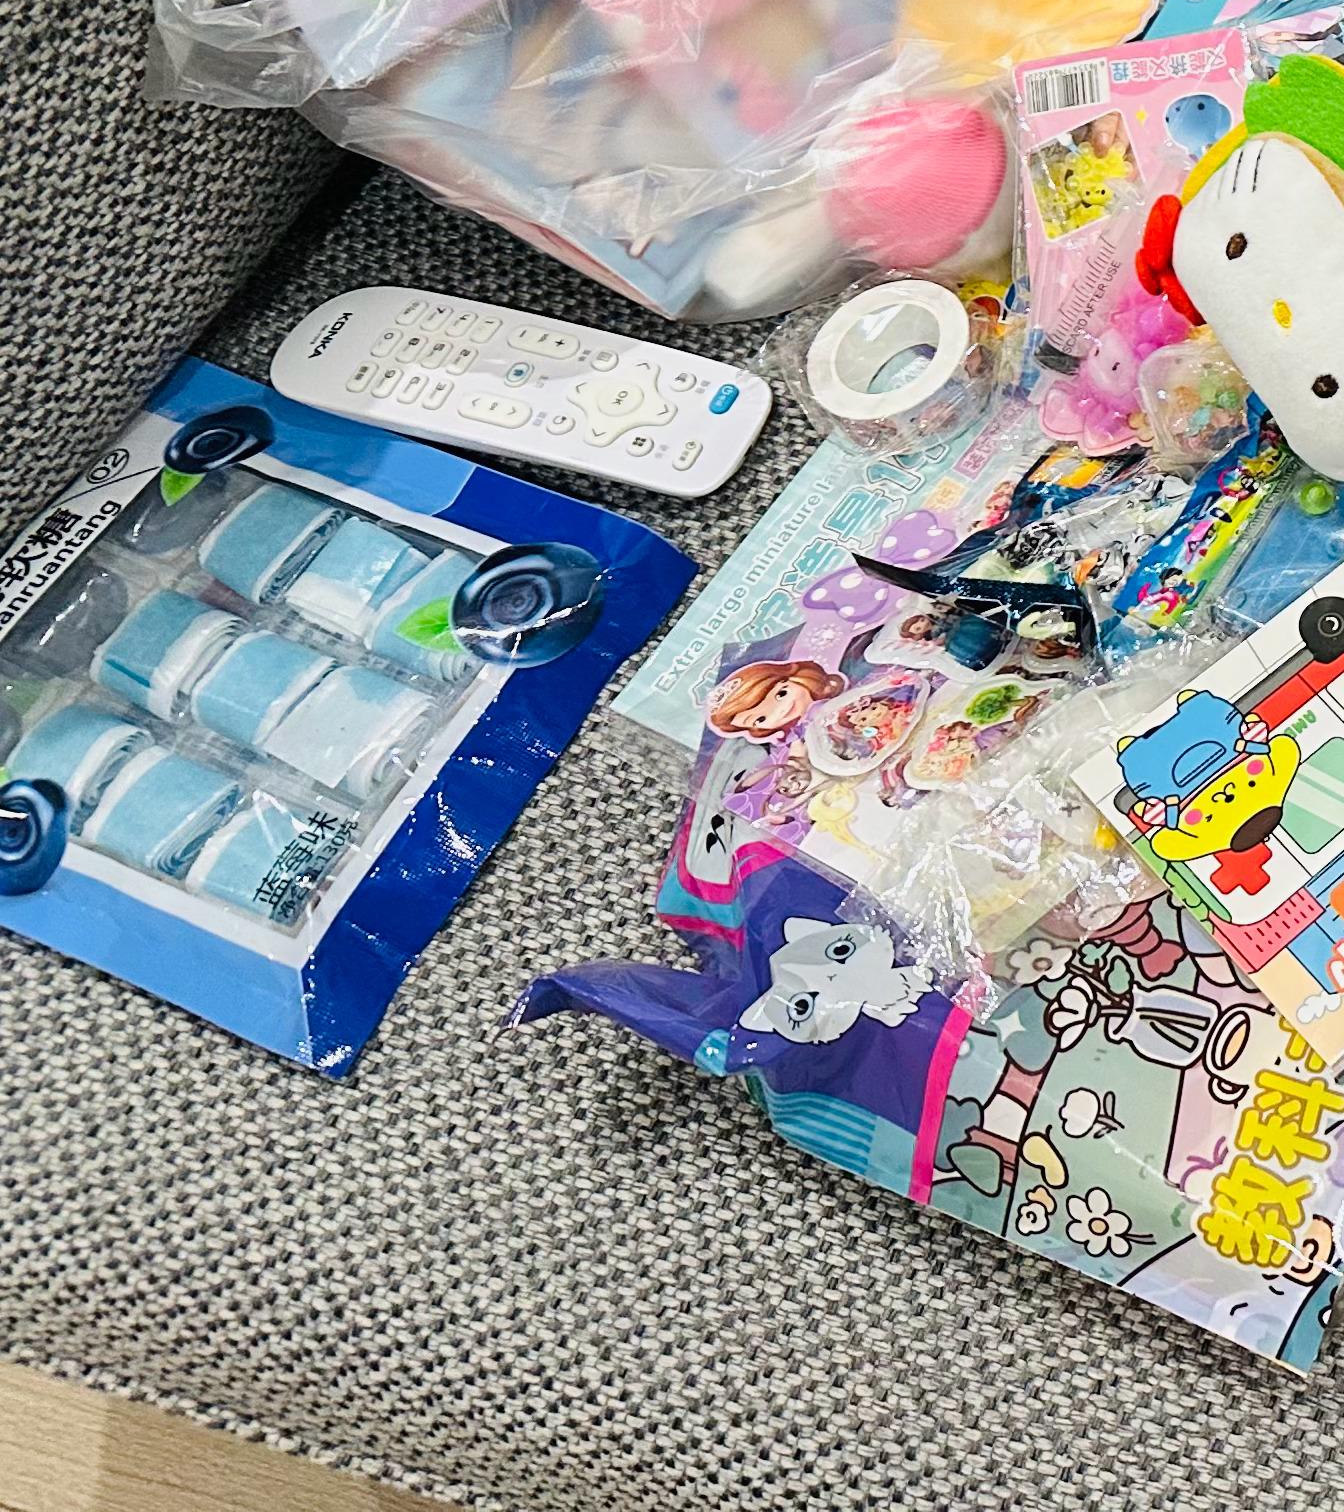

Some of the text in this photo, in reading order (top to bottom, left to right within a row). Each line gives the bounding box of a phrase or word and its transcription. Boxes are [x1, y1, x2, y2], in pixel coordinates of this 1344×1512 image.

[1083, 282, 1108, 318] AFTER
[1104, 259, 1121, 283] USE
[308, 312, 353, 359] KONKA
[613, 390, 629, 406] OK
[0, 505, 82, 592] 软糖
[0, 499, 122, 630] anruantang
[653, 636, 708, 695] Extra
[698, 582, 751, 640] large
[744, 490, 824, 586] miniature
[252, 809, 340, 910] 蓝莓味
